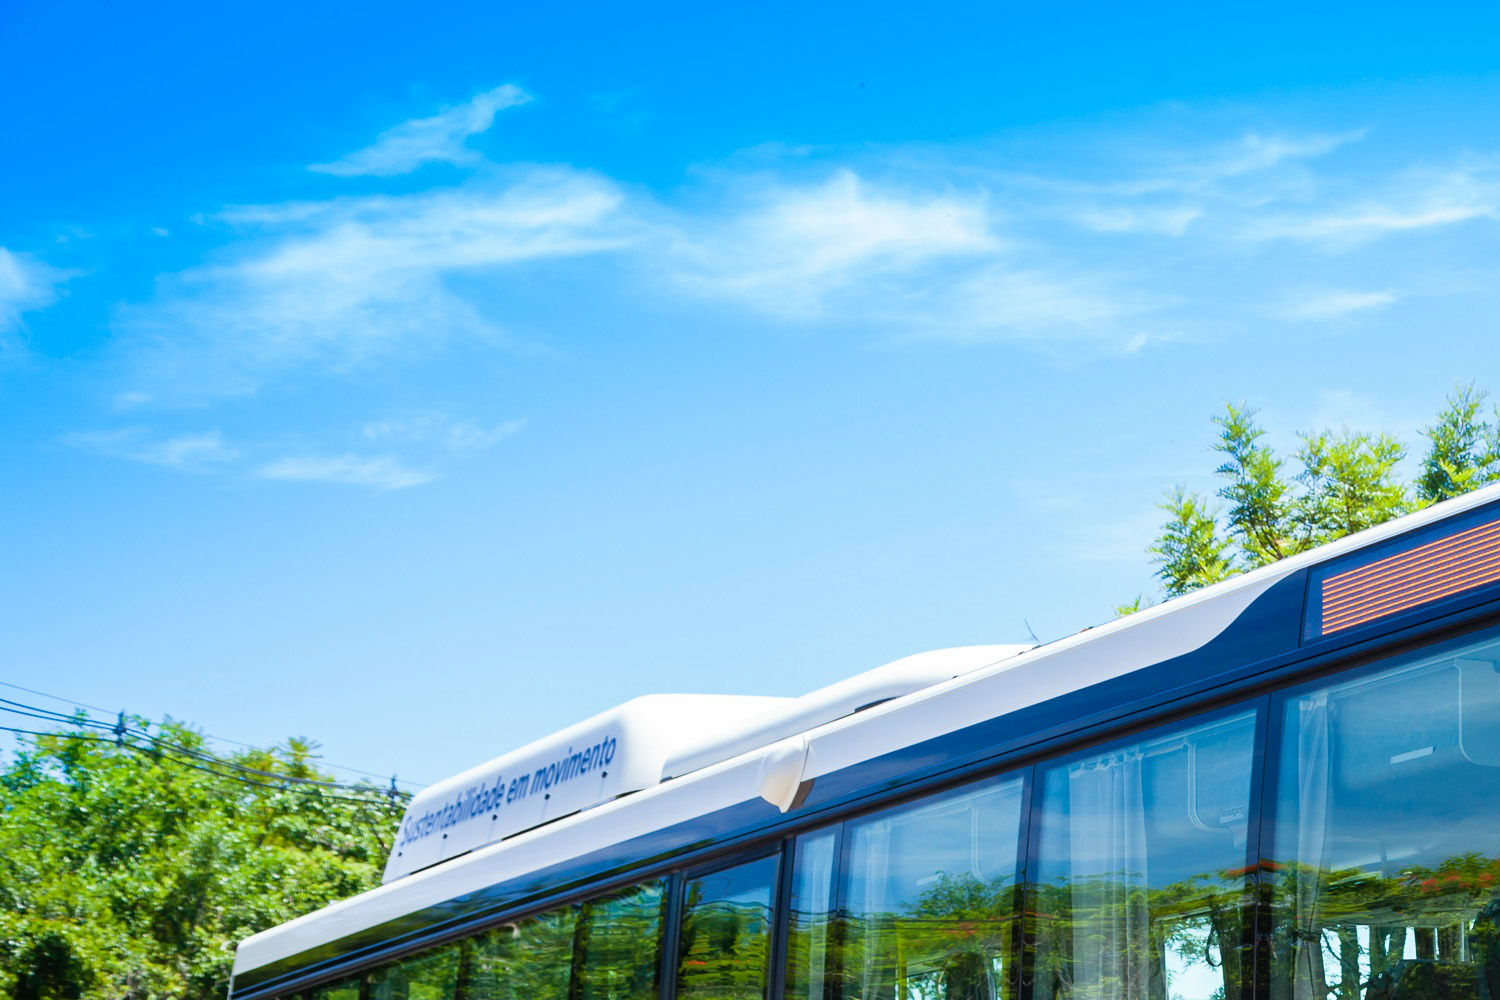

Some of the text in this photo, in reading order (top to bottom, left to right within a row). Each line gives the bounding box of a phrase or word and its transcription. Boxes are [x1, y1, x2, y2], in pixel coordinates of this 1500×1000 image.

[401, 735, 616, 845] Sustentabilidade em movimento
